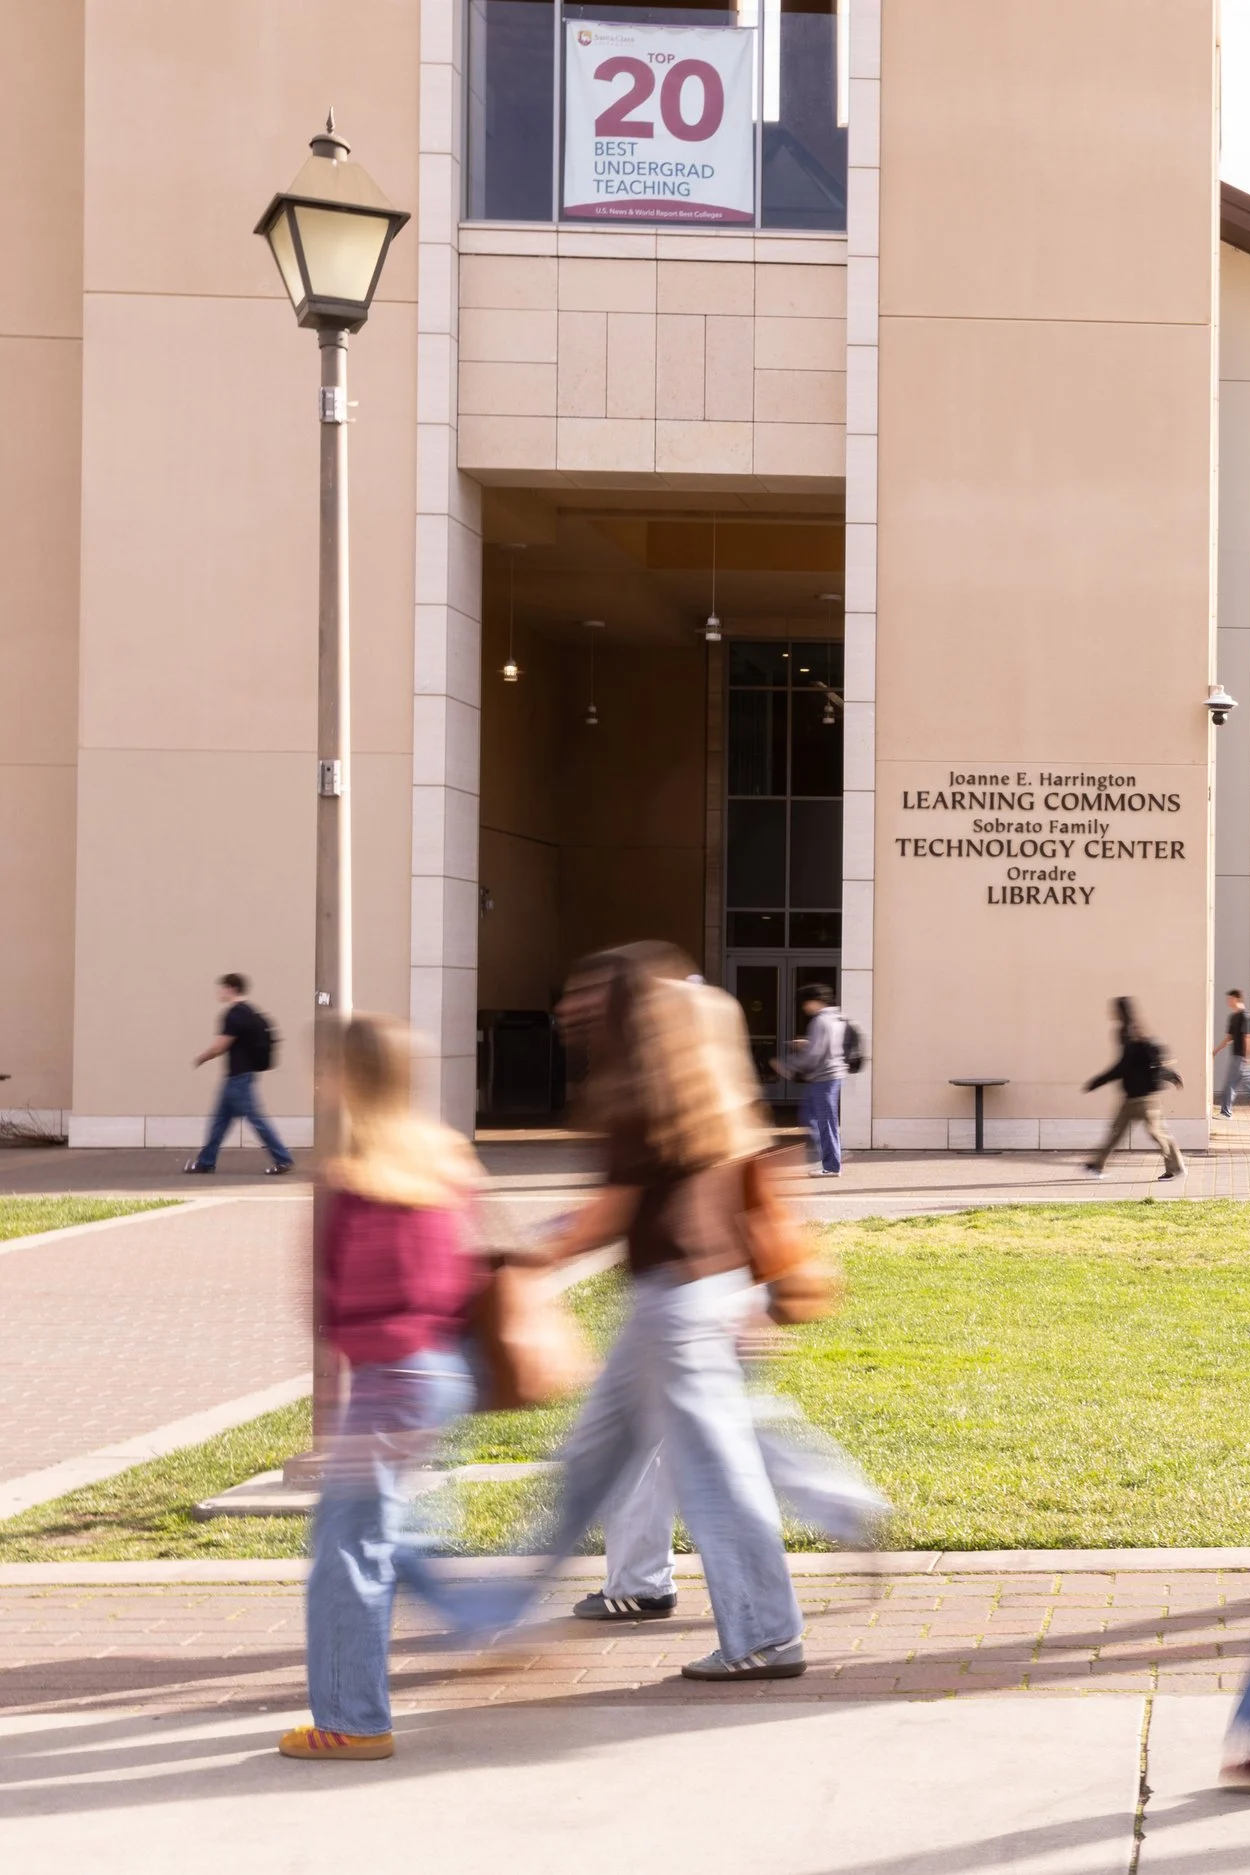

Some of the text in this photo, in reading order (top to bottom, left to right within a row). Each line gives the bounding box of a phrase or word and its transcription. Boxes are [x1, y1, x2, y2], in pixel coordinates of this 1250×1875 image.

[648, 52, 675, 64] TOP
[593, 56, 724, 141] 20
[594, 142, 638, 157] BEST
[594, 160, 715, 179] UNDERGRAD
[593, 179, 691, 197] TEACHING
[635, 208, 655, 216] World
[656, 209, 678, 217] Report
[694, 210, 723, 219] Colleges
[949, 771, 1137, 791] Joanne E. Harrington
[902, 791, 1181, 812] LEARNING COMMONS
[973, 818, 1110, 838] Sobrato Family
[895, 838, 1186, 859] TECHNOLOGY CENTER
[1007, 866, 1077, 881] Orradre
[987, 886, 1096, 905] LIBRARY
